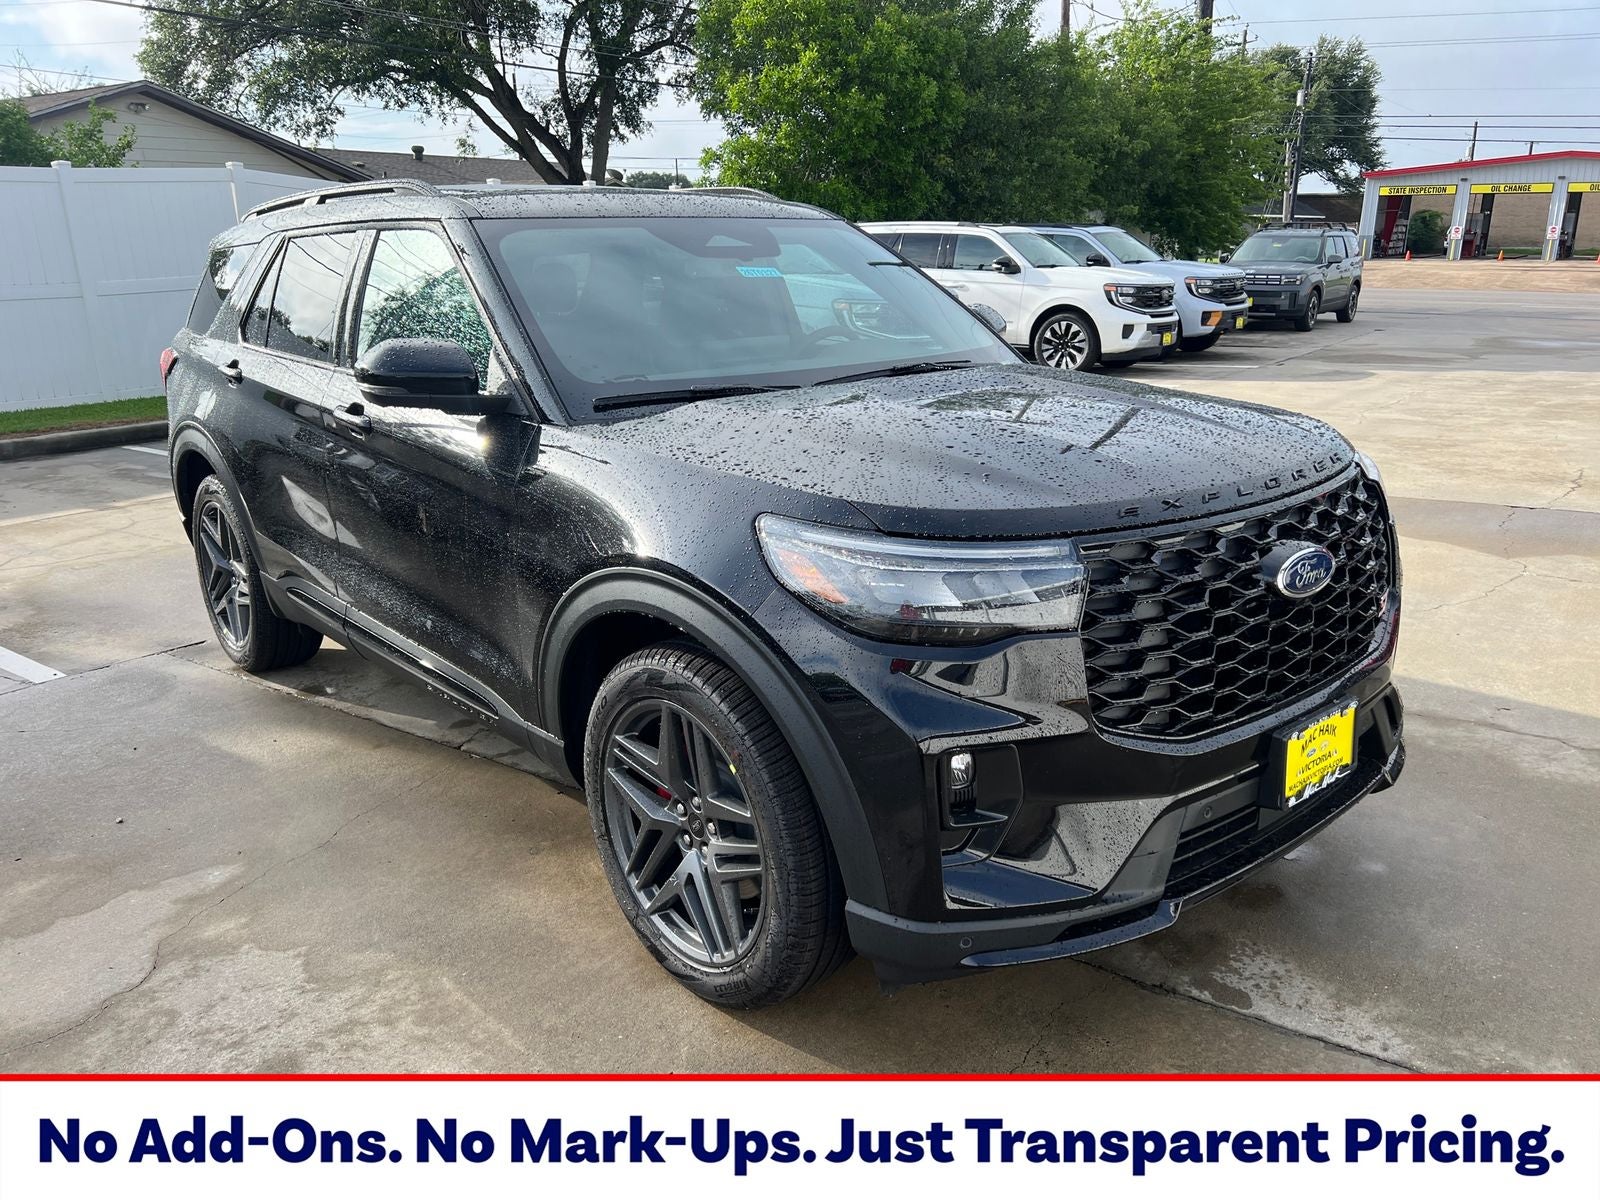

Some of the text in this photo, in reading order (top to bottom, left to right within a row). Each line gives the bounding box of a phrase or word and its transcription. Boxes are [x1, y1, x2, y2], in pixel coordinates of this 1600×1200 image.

[1388, 186, 1448, 195] STATE INSPECTION
[1503, 184, 1532, 192] CHANGE
[1118, 451, 1344, 518] EXPLORER
[1296, 557, 1327, 589] Ford
[1301, 723, 1338, 755] MAC HAIK
[1301, 750, 1332, 774] VICTORIA
